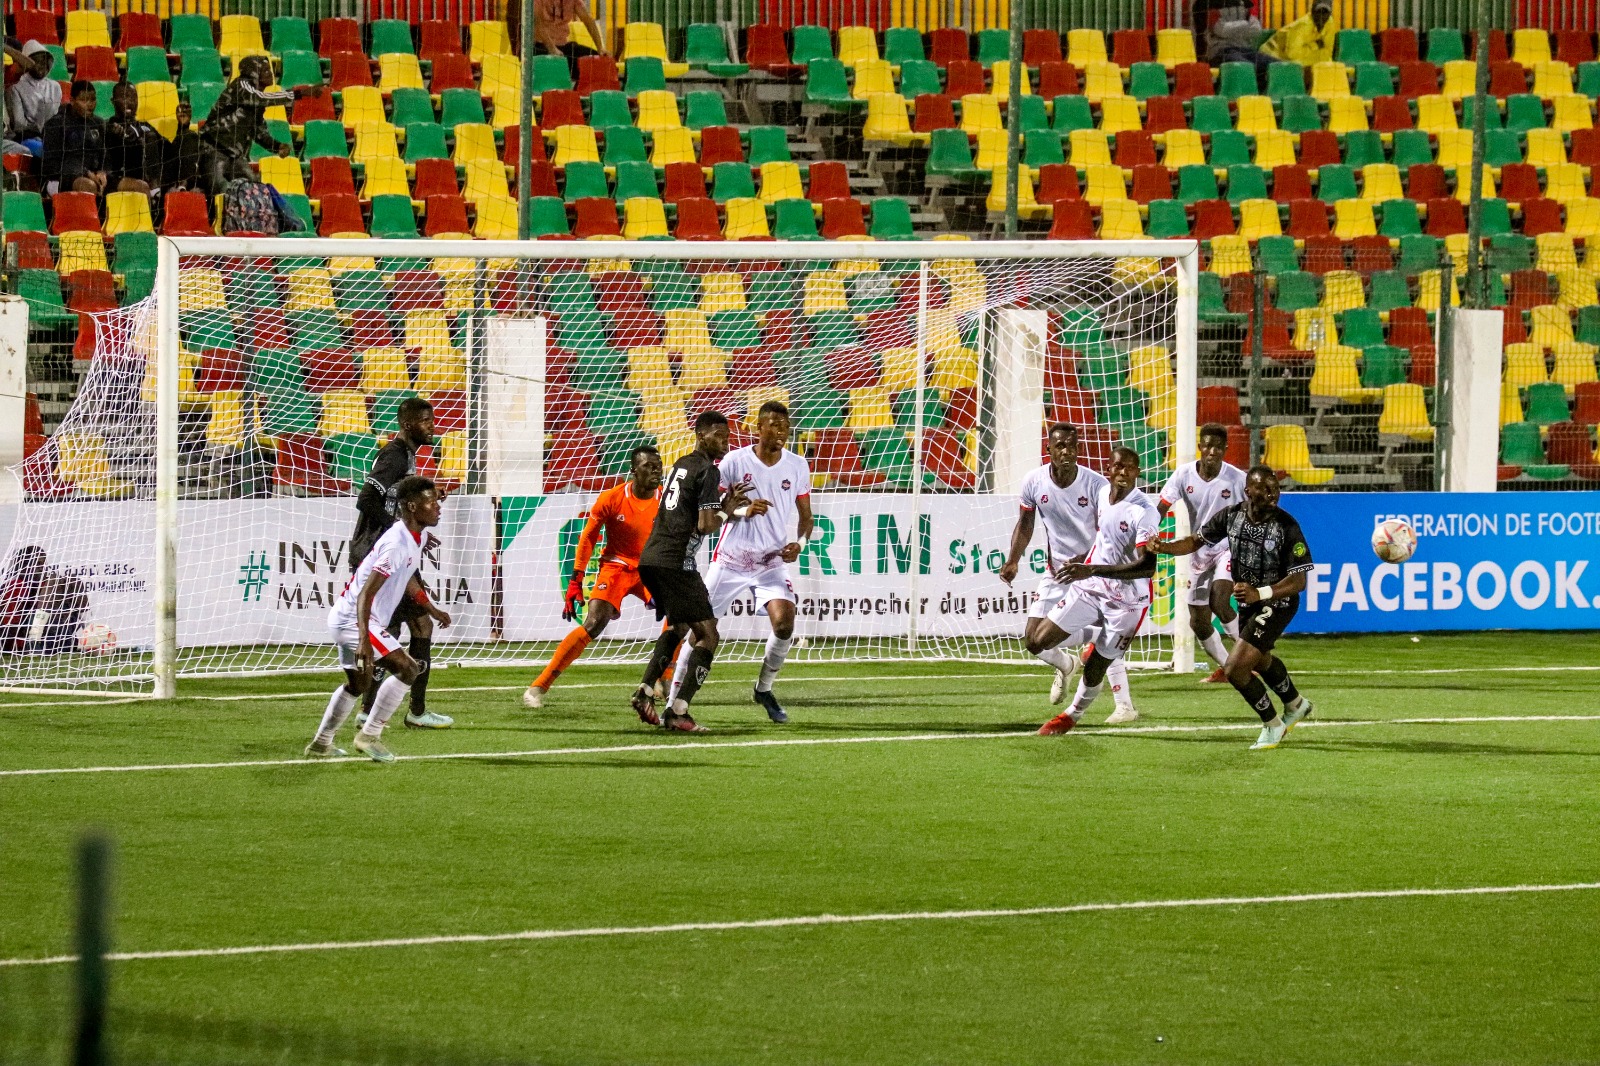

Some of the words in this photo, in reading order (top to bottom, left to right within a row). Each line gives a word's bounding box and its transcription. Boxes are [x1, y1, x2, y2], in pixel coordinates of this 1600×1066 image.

[1374, 513, 1498, 537] FERATION
[1506, 513, 1531, 536] DE
[1538, 512, 1600, 536] FOOT
[948, 538, 1048, 575] Stoe
[277, 577, 474, 610] MAUNIA
[1306, 560, 1600, 612] FACEBOOK.
[940, 592, 966, 615] du
[977, 591, 1036, 619] publi
[1255, 606, 1273, 626] 2
